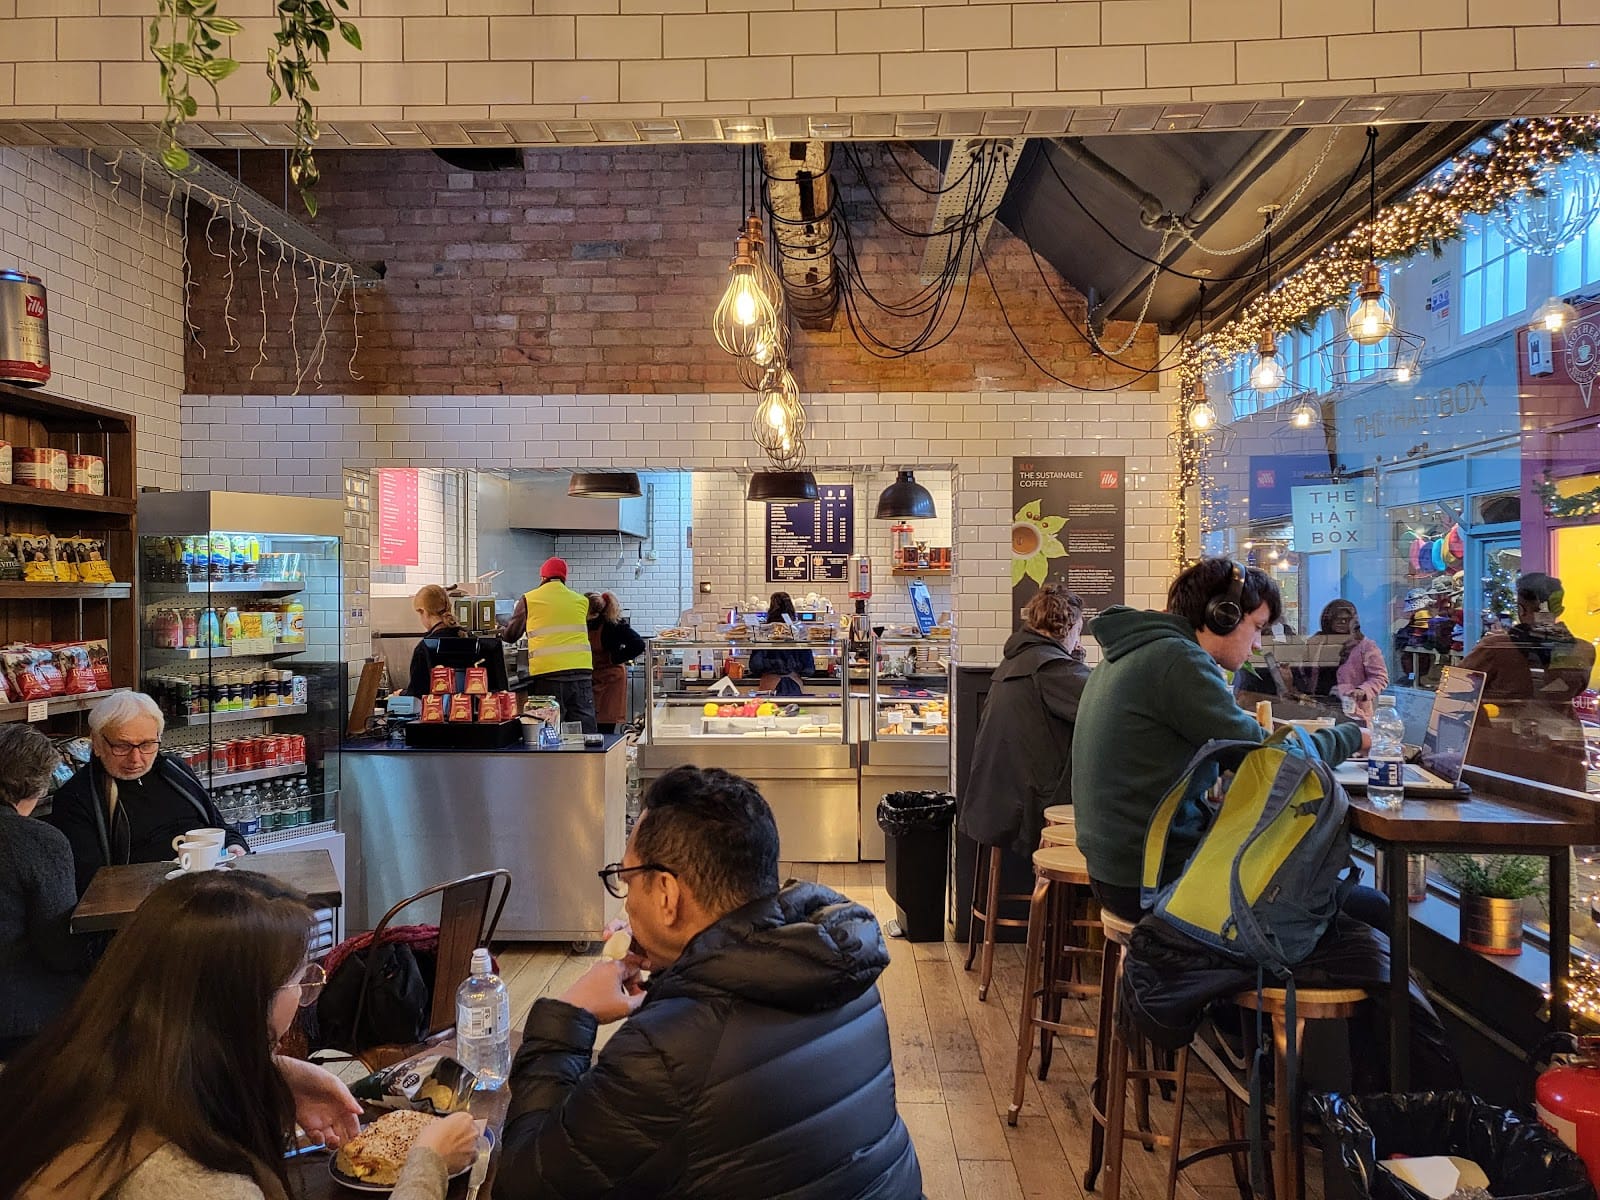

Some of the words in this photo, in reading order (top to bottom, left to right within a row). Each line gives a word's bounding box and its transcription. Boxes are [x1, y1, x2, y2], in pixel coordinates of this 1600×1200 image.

[27, 299, 44, 317] illy
[1354, 410, 1385, 443] THE
[1438, 374, 1488, 419] BOX
[1101, 473, 1117, 487] illy
[1309, 490, 1356, 504] THE
[1311, 510, 1357, 524] HAT
[1312, 530, 1358, 544] BOX
